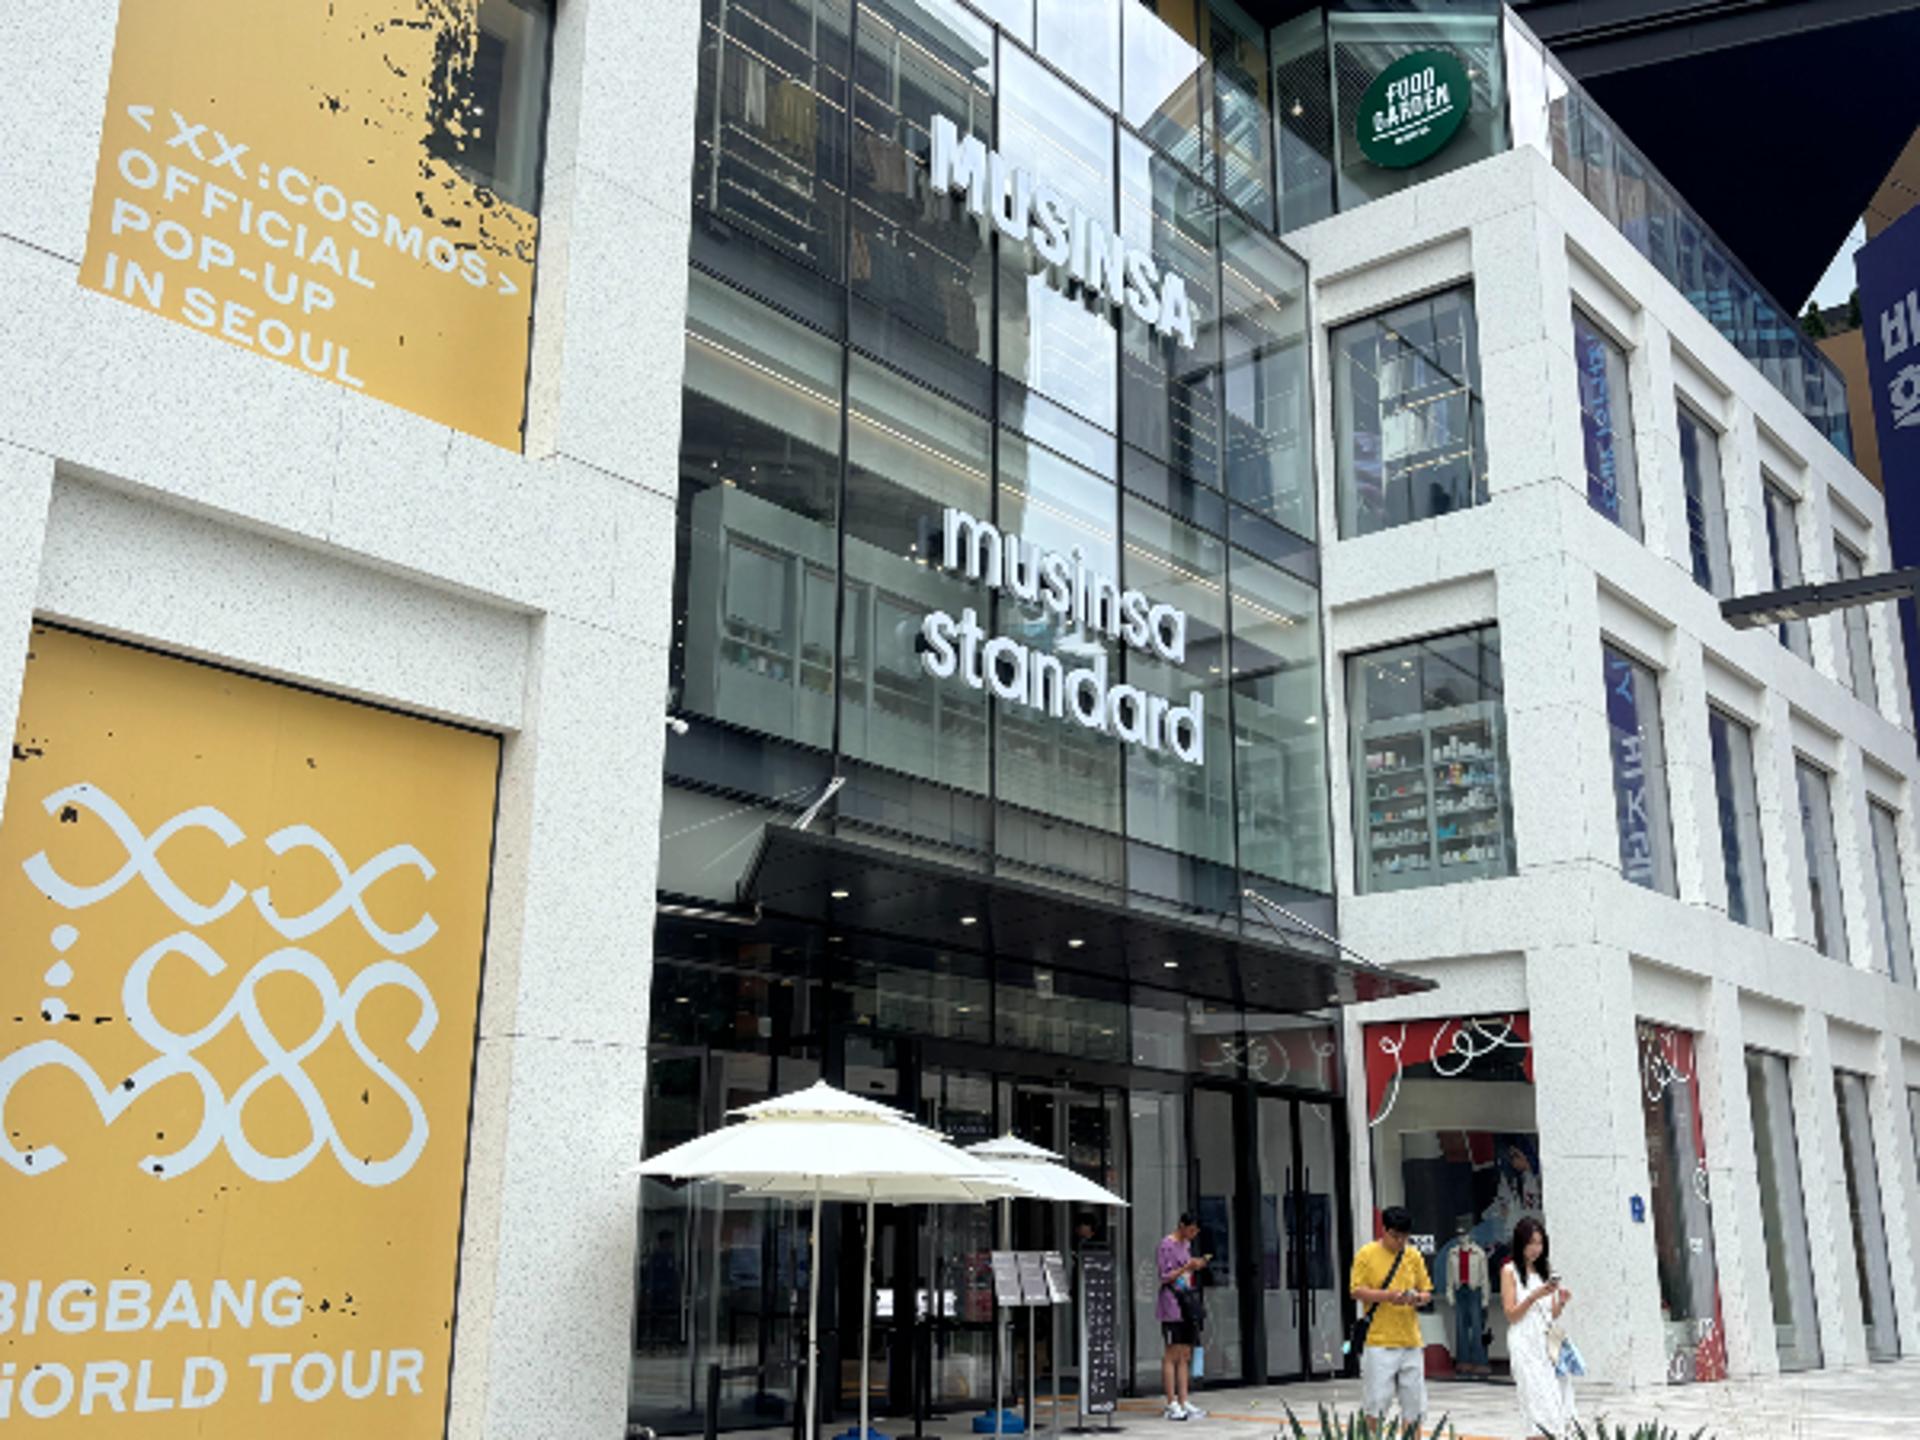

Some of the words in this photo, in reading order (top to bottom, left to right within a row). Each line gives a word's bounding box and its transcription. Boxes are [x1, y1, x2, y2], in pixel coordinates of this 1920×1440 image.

[1372, 82, 1451, 132] GARDEN
[1385, 66, 1435, 104] FOOD
[111, 198, 336, 315] POP-UP
[117, 148, 376, 290] OFFICIAL
[931, 112, 1195, 349] MUSINSA
[103, 252, 165, 308] IN
[181, 285, 365, 389] SEOUL
[943, 507, 1186, 664] musinsa
[920, 606, 1205, 766] standard
[0, 1355, 229, 1420] ORLD
[248, 1348, 425, 1404] TOUR
